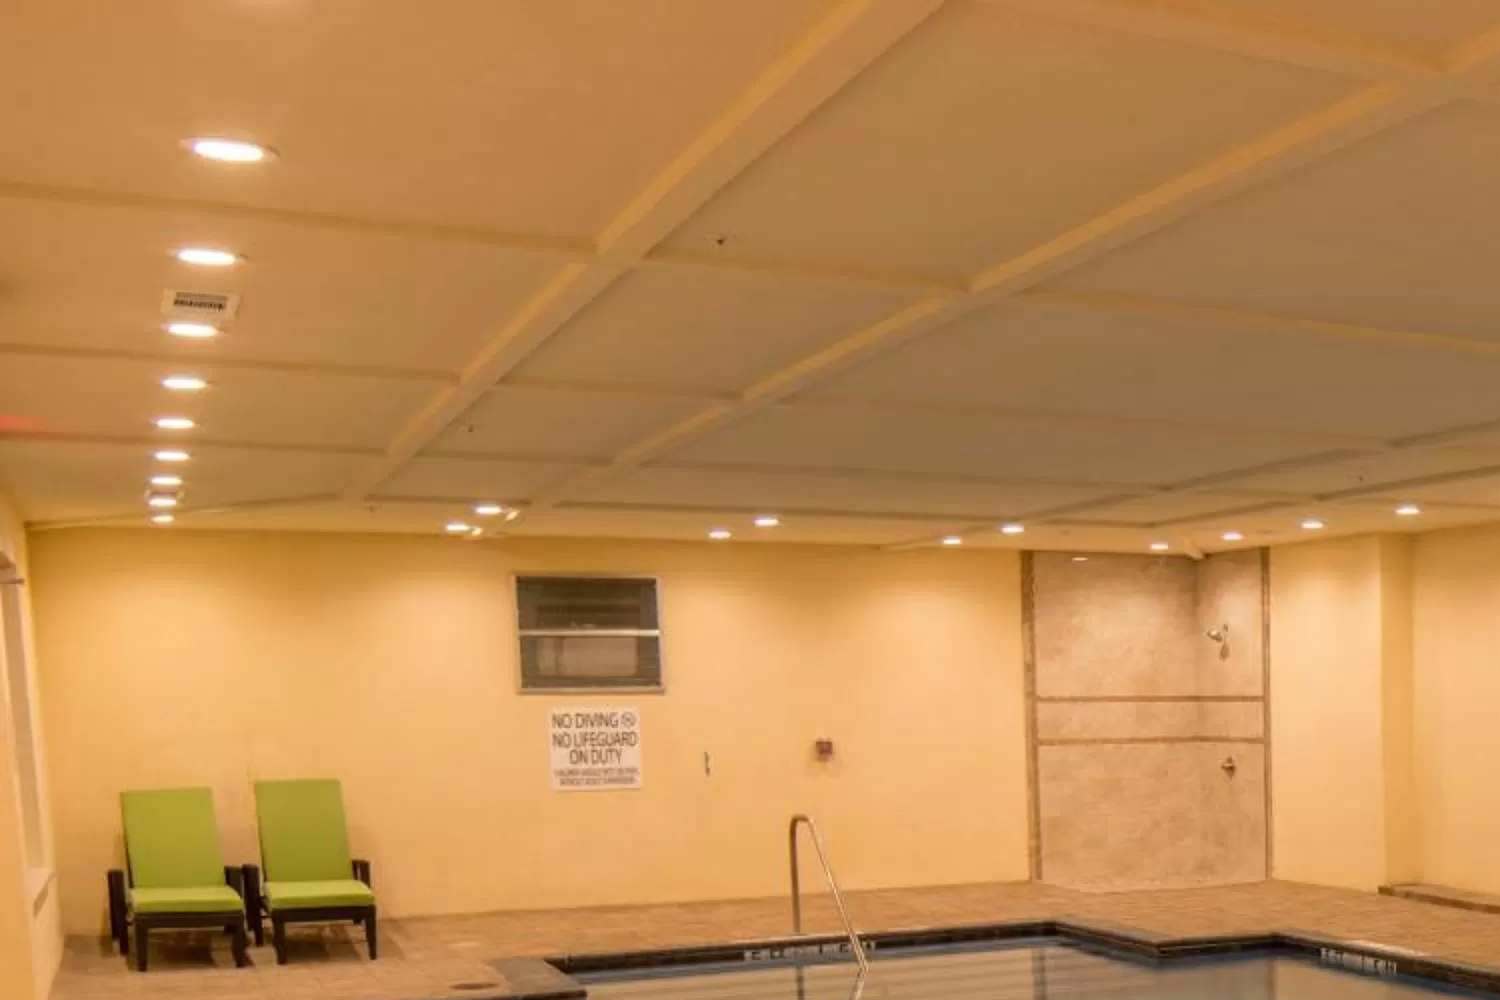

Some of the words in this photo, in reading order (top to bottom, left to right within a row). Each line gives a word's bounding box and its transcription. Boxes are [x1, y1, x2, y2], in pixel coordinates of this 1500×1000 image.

[552, 712, 572, 728] NO
[575, 711, 619, 728] DIVING
[552, 732, 571, 748] NO
[573, 731, 638, 748] LIFEGUARD
[569, 748, 588, 764] ON
[591, 748, 622, 764] DUTY
